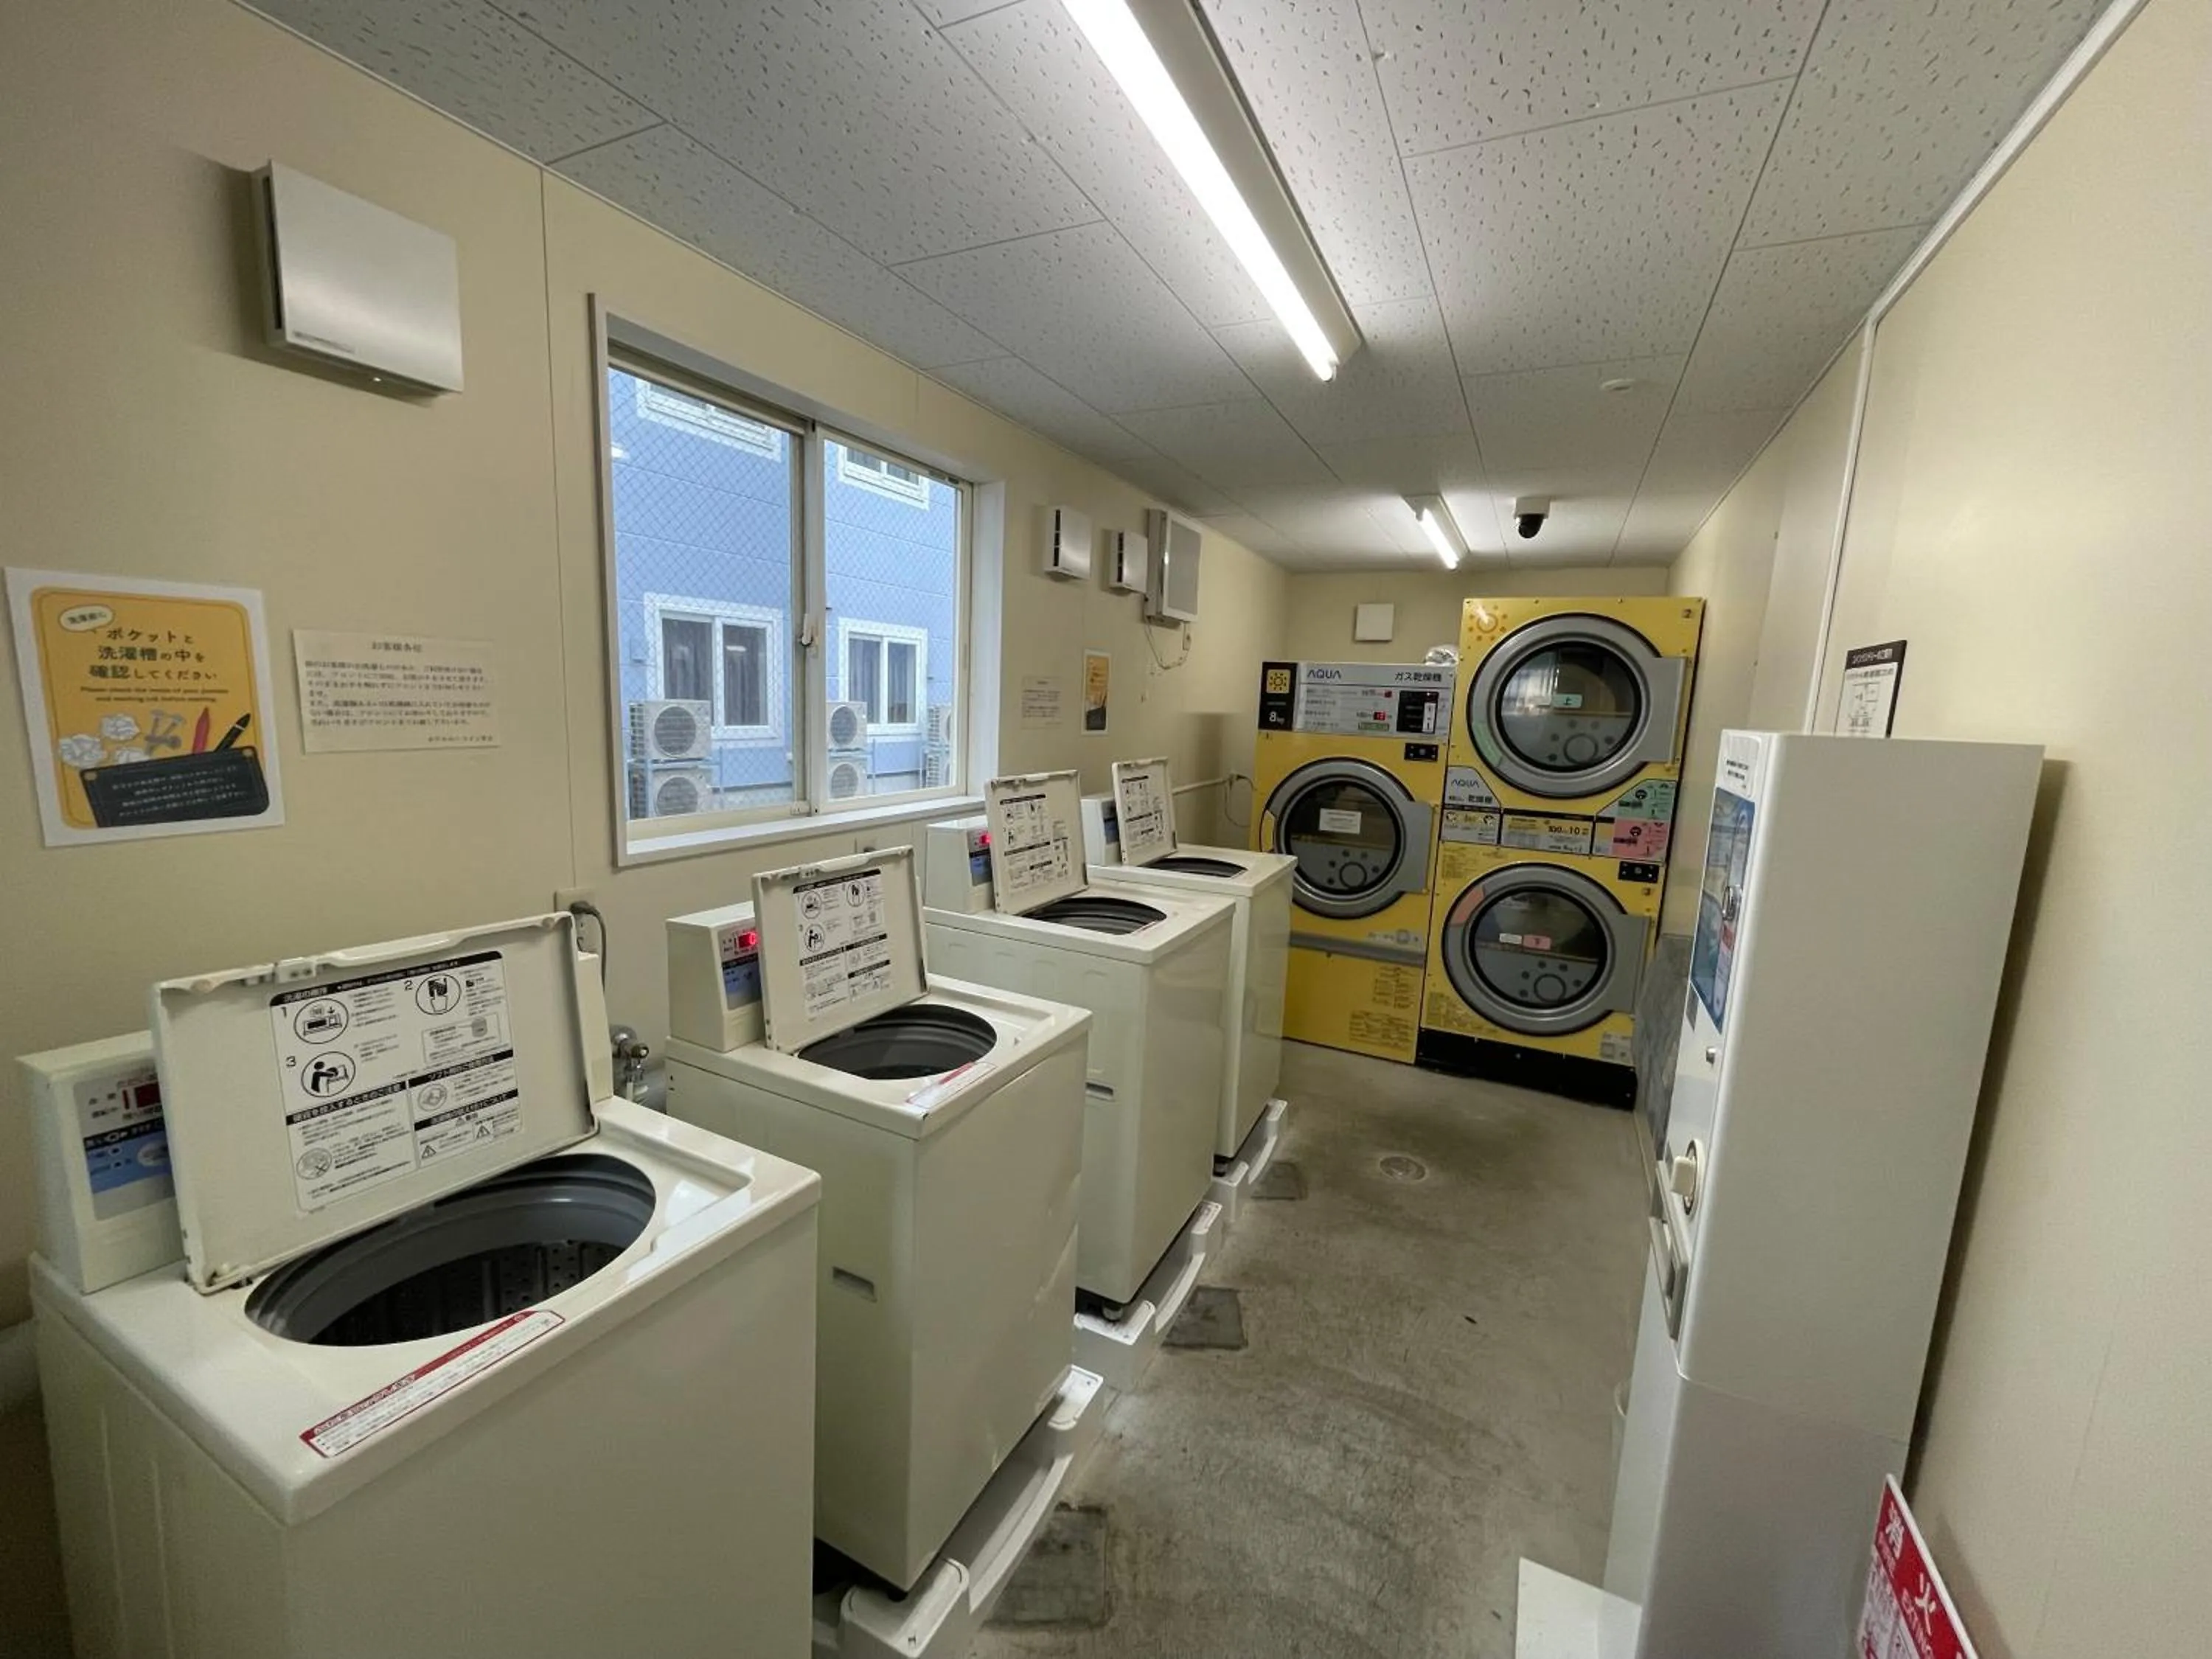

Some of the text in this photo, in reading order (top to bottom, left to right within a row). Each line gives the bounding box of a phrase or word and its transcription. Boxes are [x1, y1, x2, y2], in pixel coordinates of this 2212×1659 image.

[106, 628, 195, 644] ポケットと
[97, 645, 206, 663] 洗濯槽の中を
[89, 664, 218, 681] 確認してください
[1307, 669, 1342, 679] AQUA
[1394, 671, 1442, 683] ガス乾燥機
[404, 980, 413, 991] 2
[281, 1006, 288, 1018] 1
[285, 1056, 296, 1068] 3
